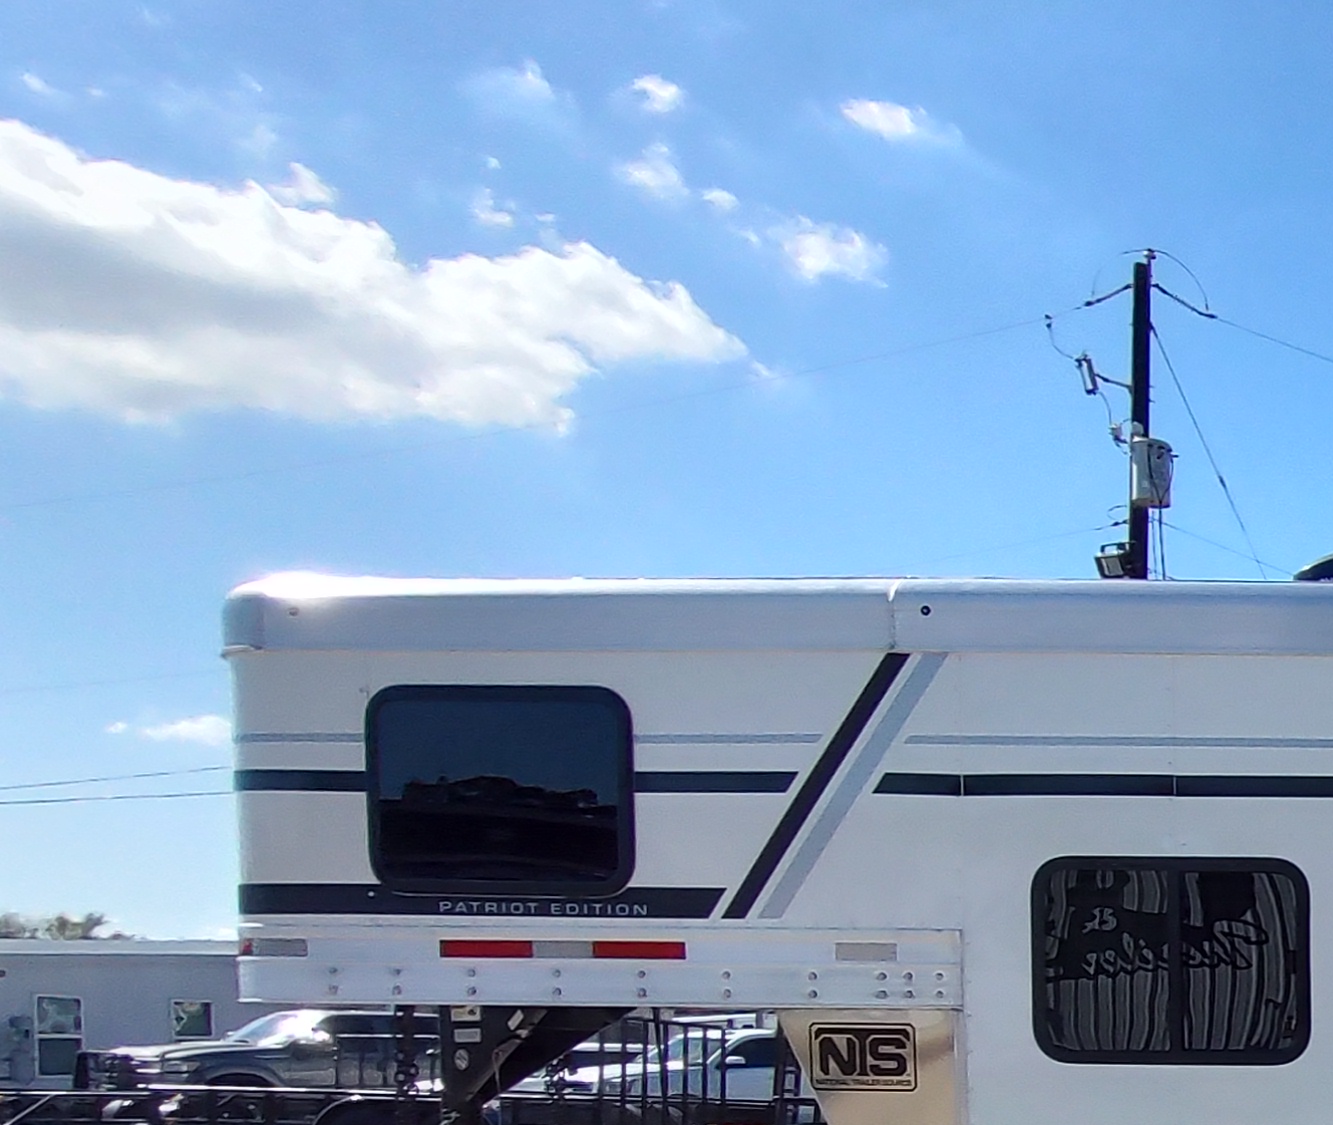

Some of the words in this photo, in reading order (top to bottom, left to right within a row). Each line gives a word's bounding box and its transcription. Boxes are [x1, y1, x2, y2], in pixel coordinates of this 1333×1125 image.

[439, 901, 539, 914] PATRIOT
[551, 903, 648, 916] EDITION
[814, 1028, 910, 1076] NTS
